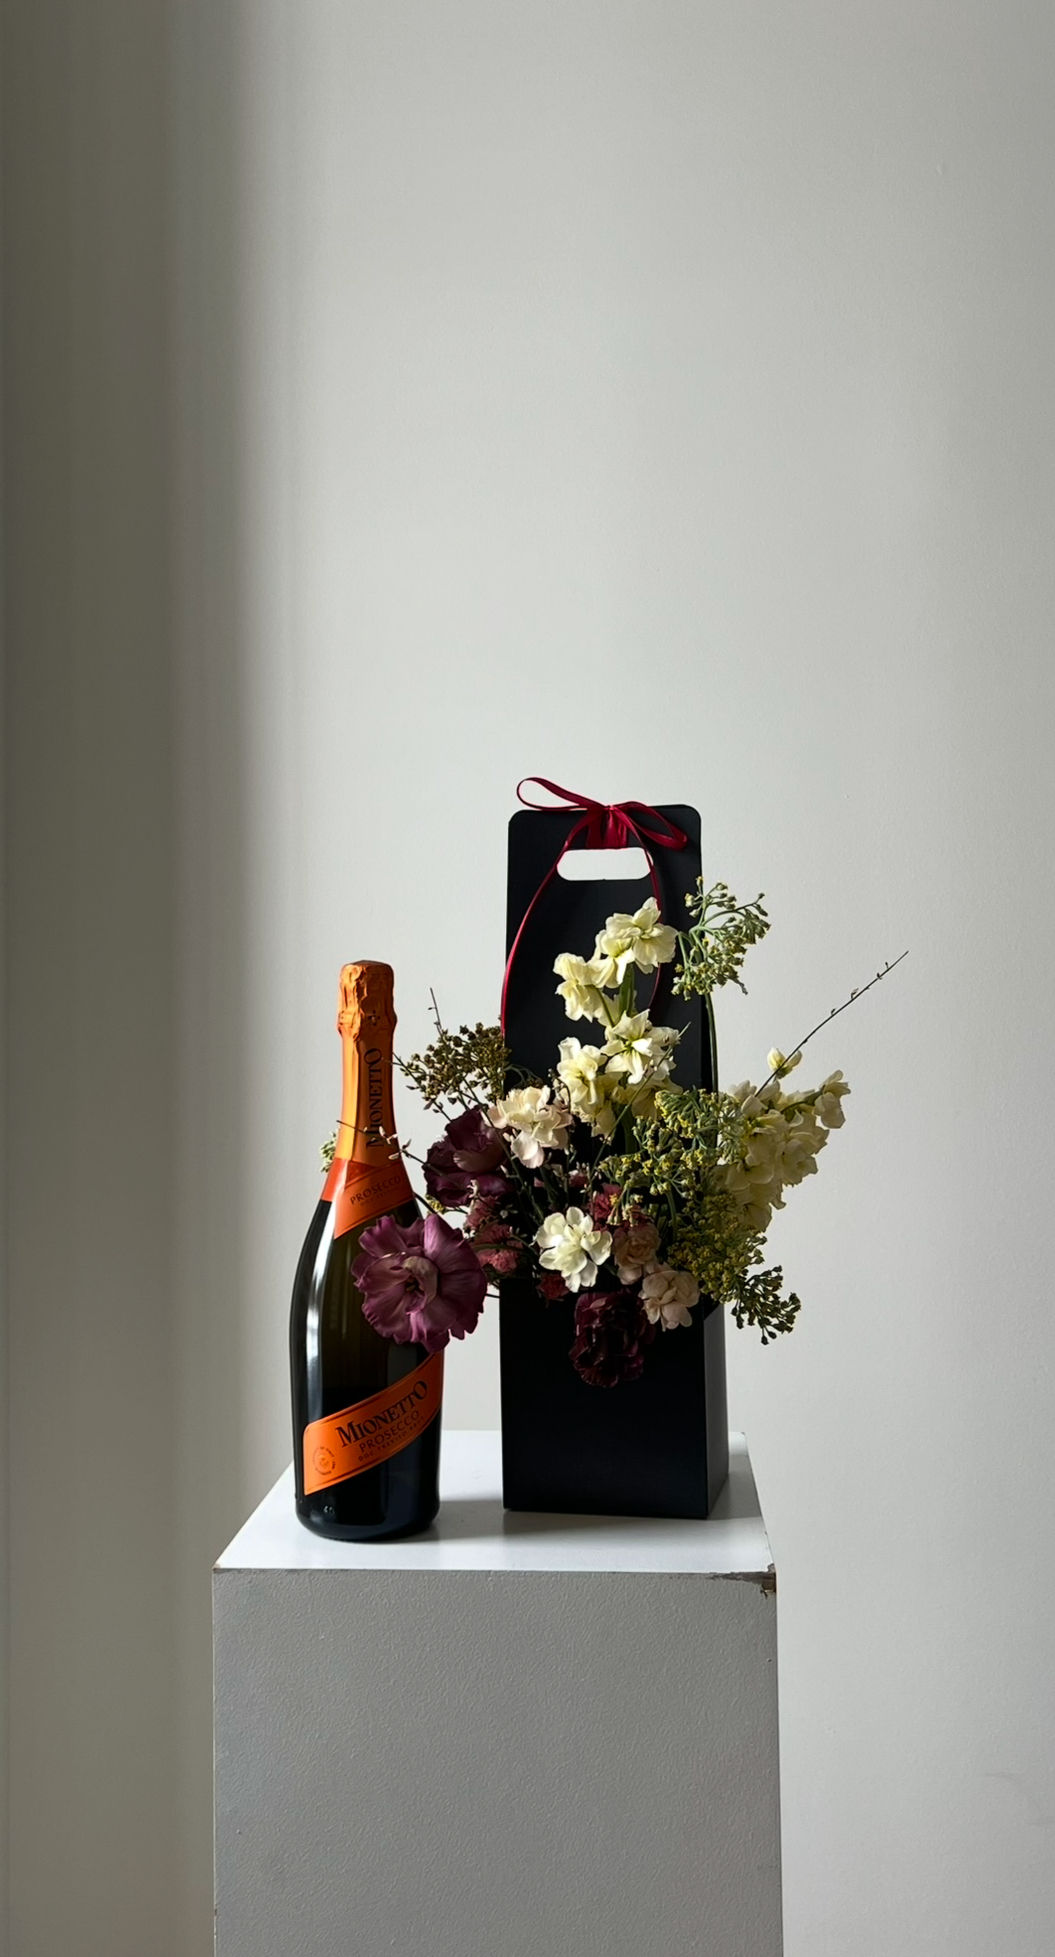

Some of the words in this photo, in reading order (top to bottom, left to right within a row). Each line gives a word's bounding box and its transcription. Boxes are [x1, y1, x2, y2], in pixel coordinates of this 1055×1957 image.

[350, 1176, 401, 1204] PROSECCO
[336, 1381, 428, 1447] MIONETTO
[359, 1410, 420, 1452] PROSECCO
